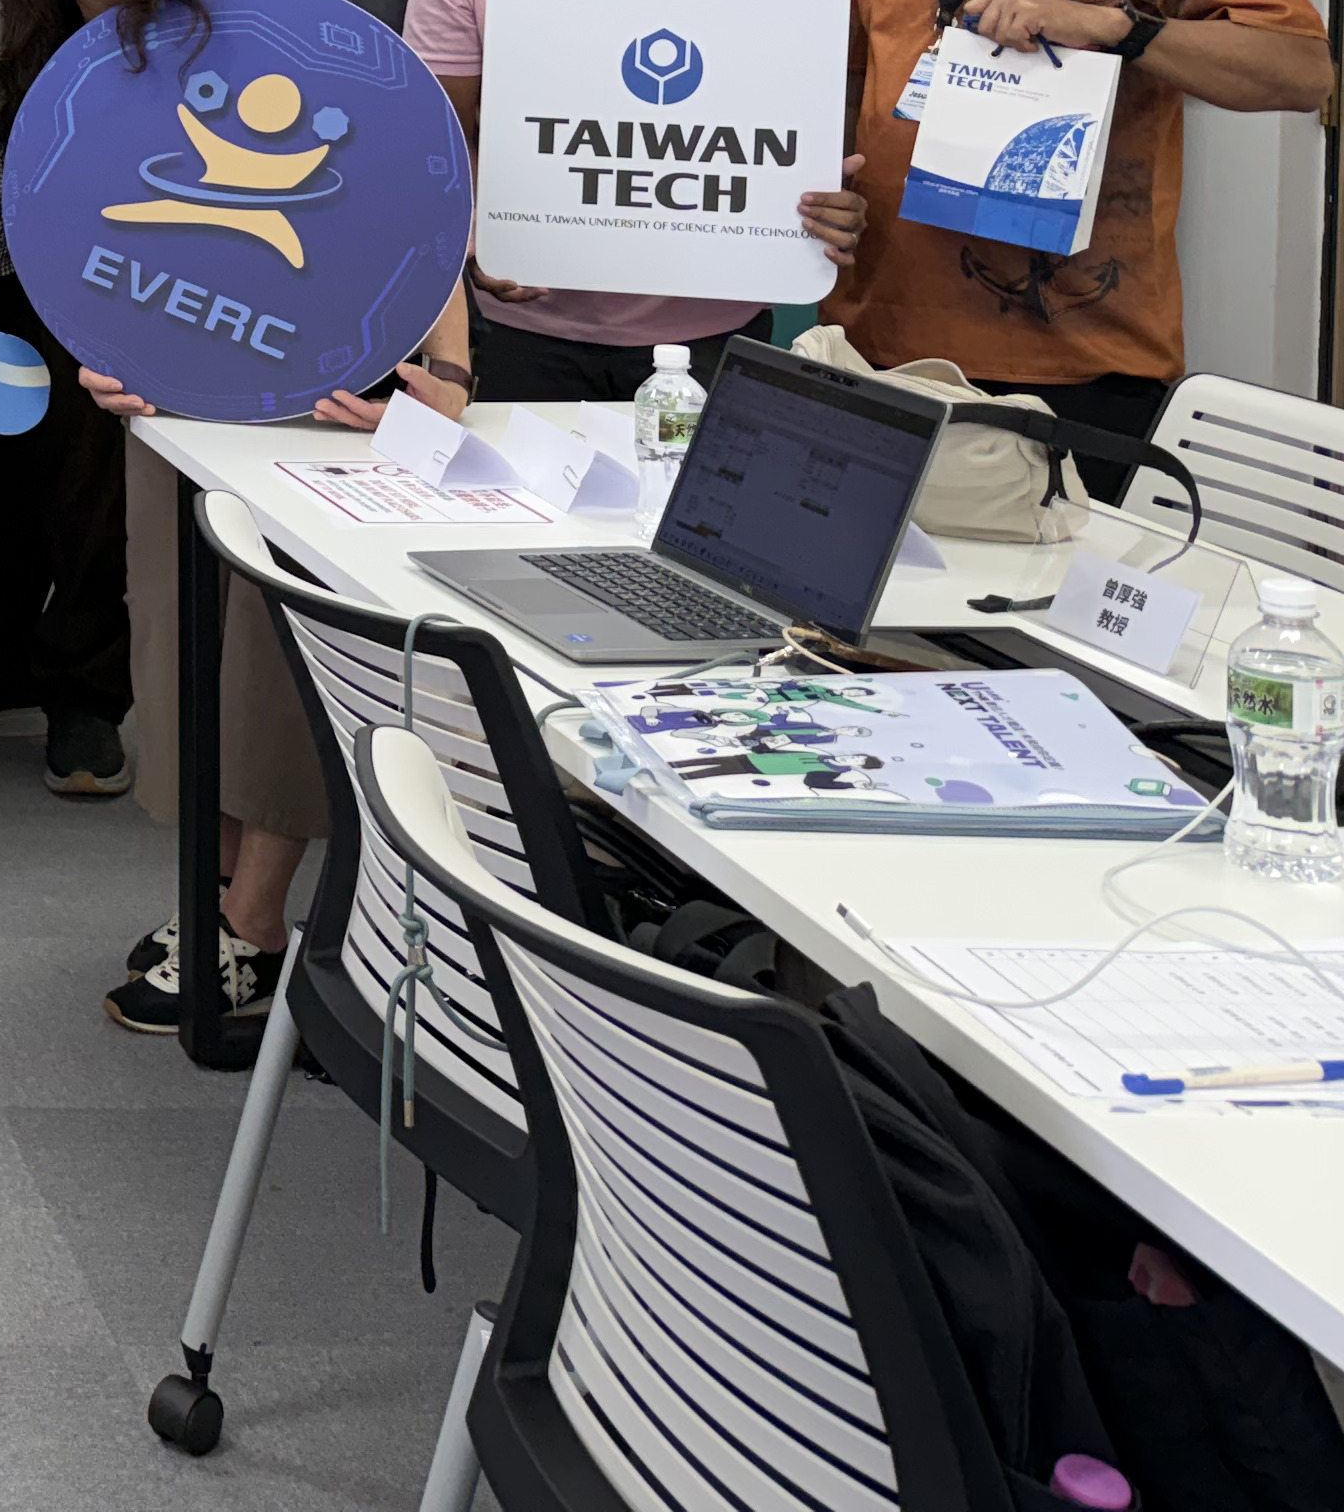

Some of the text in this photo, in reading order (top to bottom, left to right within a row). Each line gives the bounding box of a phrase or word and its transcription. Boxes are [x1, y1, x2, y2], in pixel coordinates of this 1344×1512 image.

[946, 74, 993, 92] TECH
[948, 61, 1022, 85] TAIWAN
[524, 116, 798, 167] TAIWAN
[568, 167, 748, 214] TECH
[487, 211, 541, 223] NATIONAL
[544, 214, 586, 226] TAIWAN
[589, 216, 653, 230] UNIVERSITY
[653, 220, 669, 231] OF
[670, 221, 718, 234] SCIENCE
[720, 224, 745, 236] AND
[81, 245, 296, 360] EVERC
[1105, 577, 1148, 612] 曾厚強
[1096, 608, 1130, 637] 教授
[935, 682, 989, 713] NEXT
[976, 715, 1049, 769] TALENT
